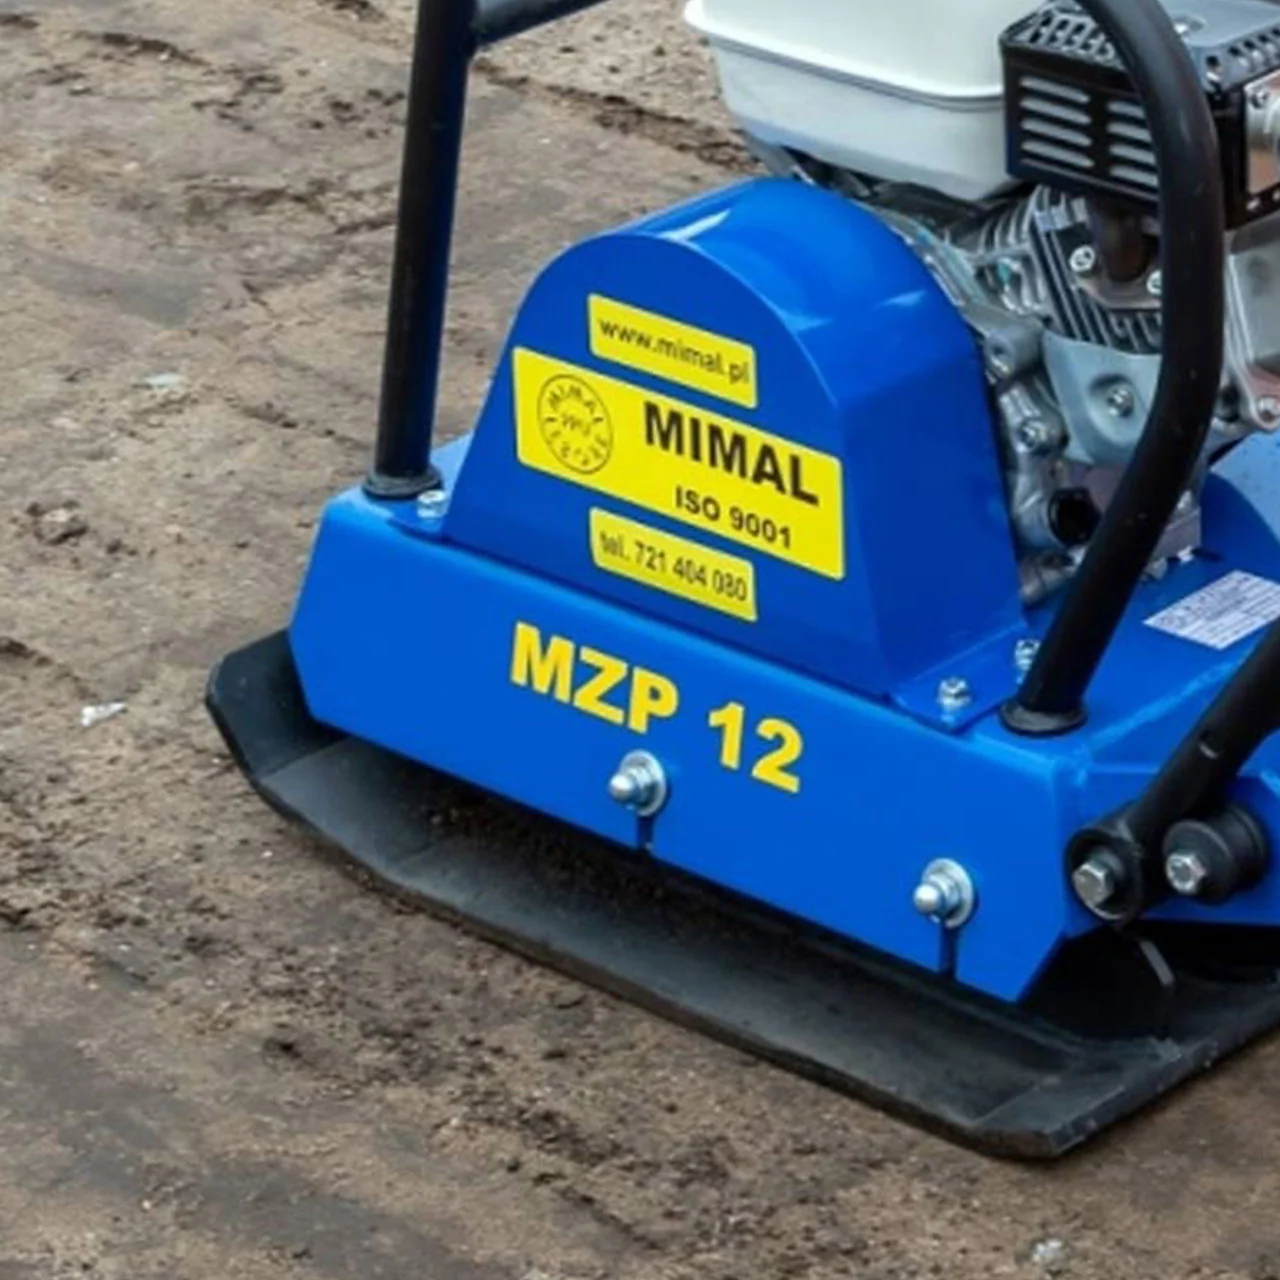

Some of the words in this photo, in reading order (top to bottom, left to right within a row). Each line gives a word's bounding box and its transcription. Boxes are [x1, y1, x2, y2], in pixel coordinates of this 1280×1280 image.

[600, 318, 749, 385] www.mimal.pl
[643, 400, 820, 507] MIMAL
[675, 484, 721, 522] ISO
[729, 506, 792, 550] 9001
[634, 539, 666, 574] 721
[510, 620, 679, 735] MZP
[708, 700, 803, 794] 12
